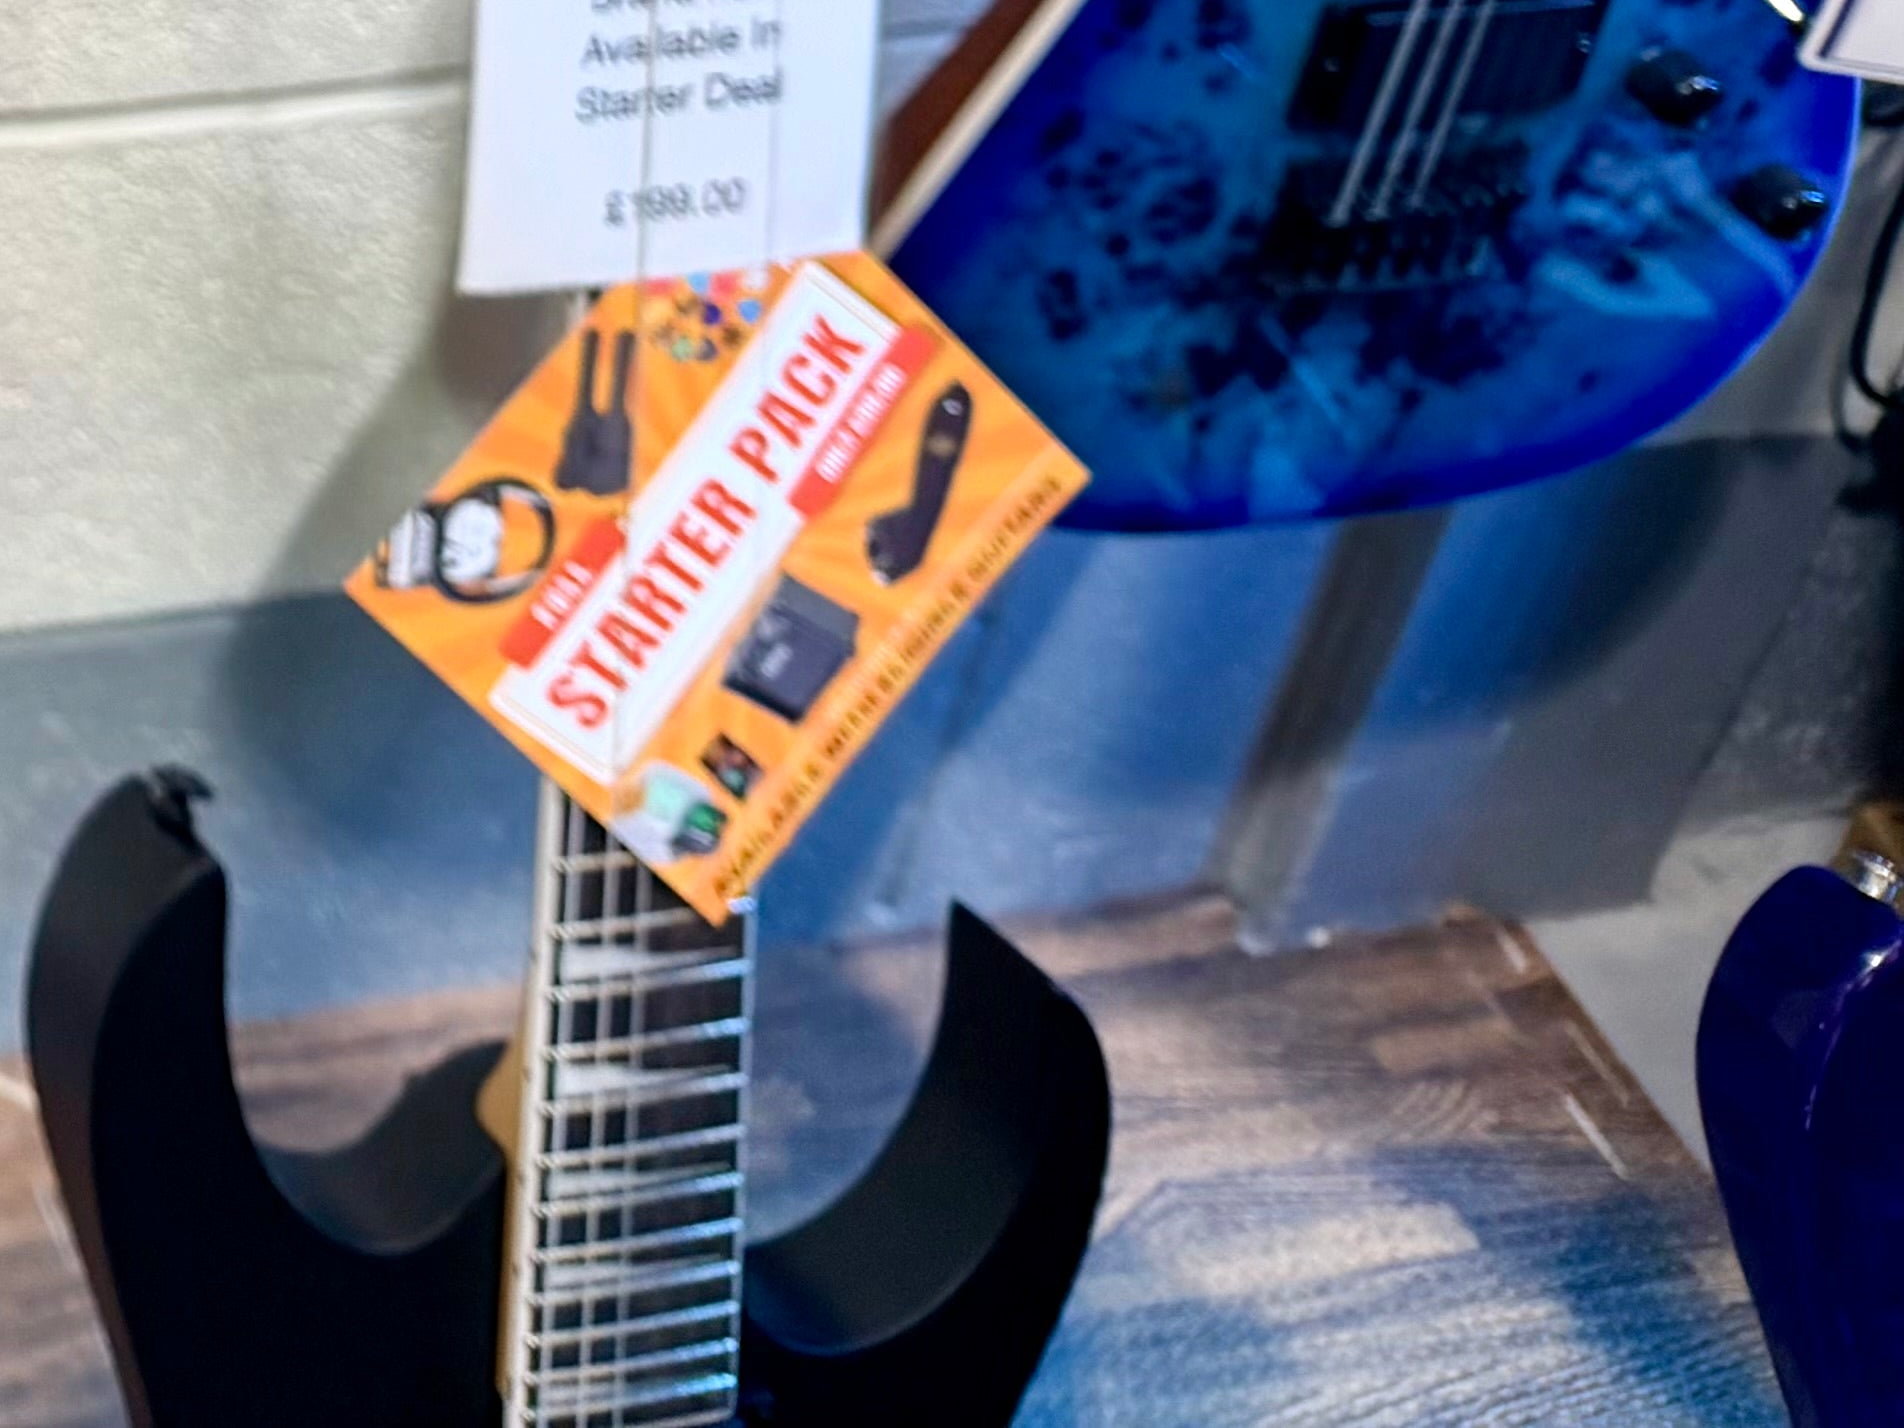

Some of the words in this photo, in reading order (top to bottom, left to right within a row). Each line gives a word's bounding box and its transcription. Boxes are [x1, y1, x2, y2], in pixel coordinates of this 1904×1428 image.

[574, 83, 694, 125] Starter
[703, 65, 784, 112] Deal
[544, 486, 755, 730] STARTER
[728, 312, 869, 484] PACK
